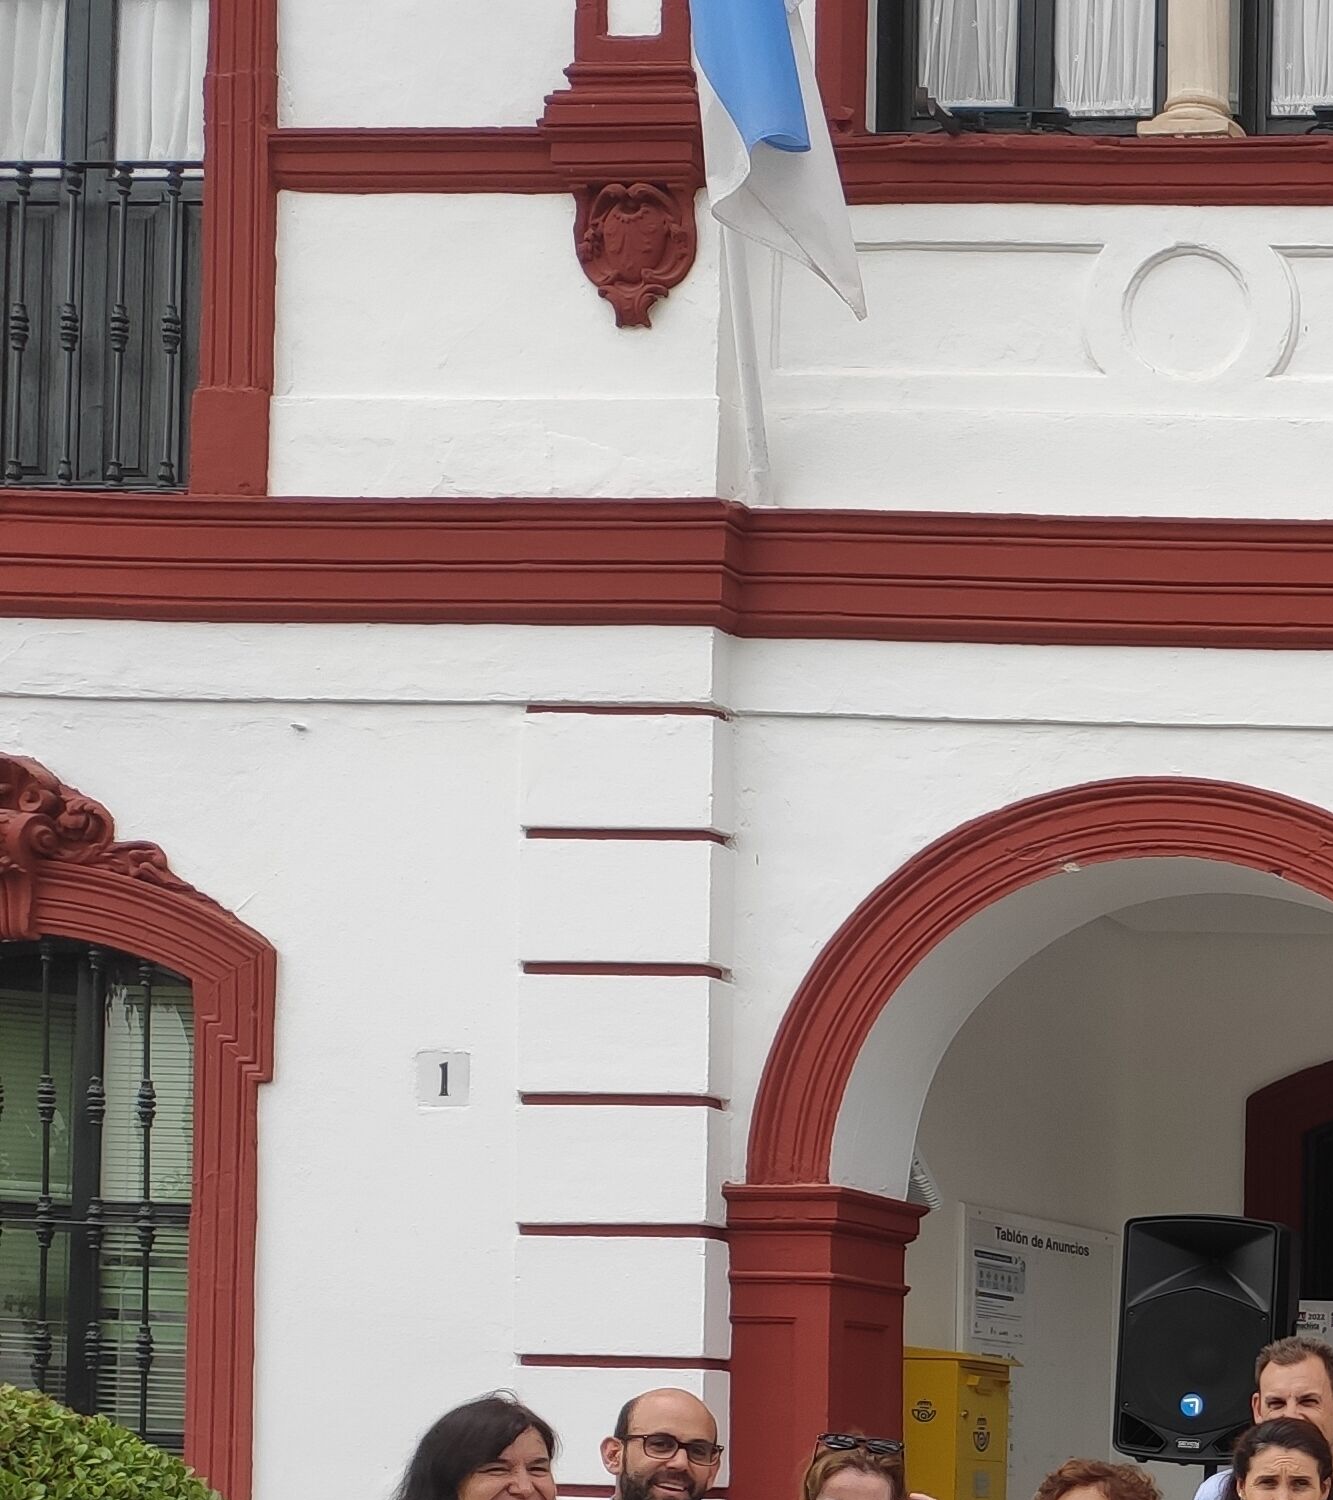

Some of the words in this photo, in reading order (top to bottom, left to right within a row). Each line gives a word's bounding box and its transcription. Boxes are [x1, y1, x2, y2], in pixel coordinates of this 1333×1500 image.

[994, 1225, 1029, 1246] Tablón
[1031, 1234, 1044, 1249] de
[1045, 1237, 1090, 1257] Anuncios
